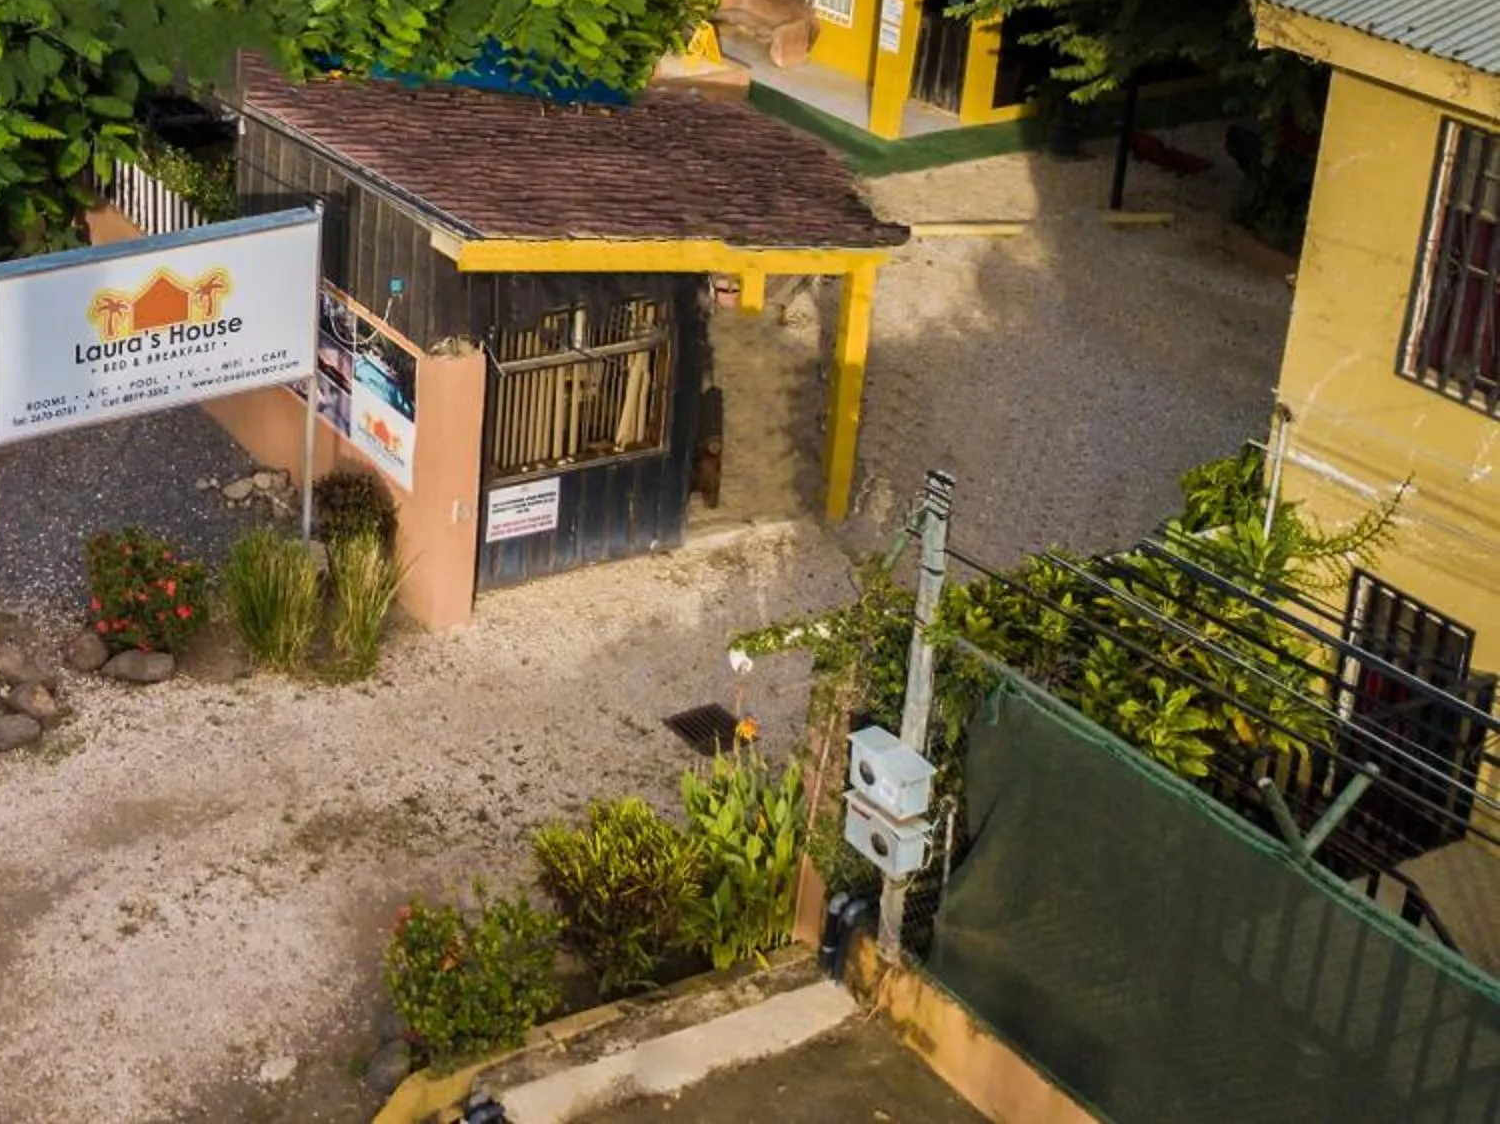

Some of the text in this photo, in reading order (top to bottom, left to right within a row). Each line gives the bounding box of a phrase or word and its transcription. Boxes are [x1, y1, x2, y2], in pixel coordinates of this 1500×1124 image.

[75, 314, 243, 365] Laura's House
[103, 341, 217, 374] BED & BREAKFAST
[26, 395, 66, 411] ROOMS
[87, 386, 109, 399] A/C
[129, 377, 159, 390] POOL
